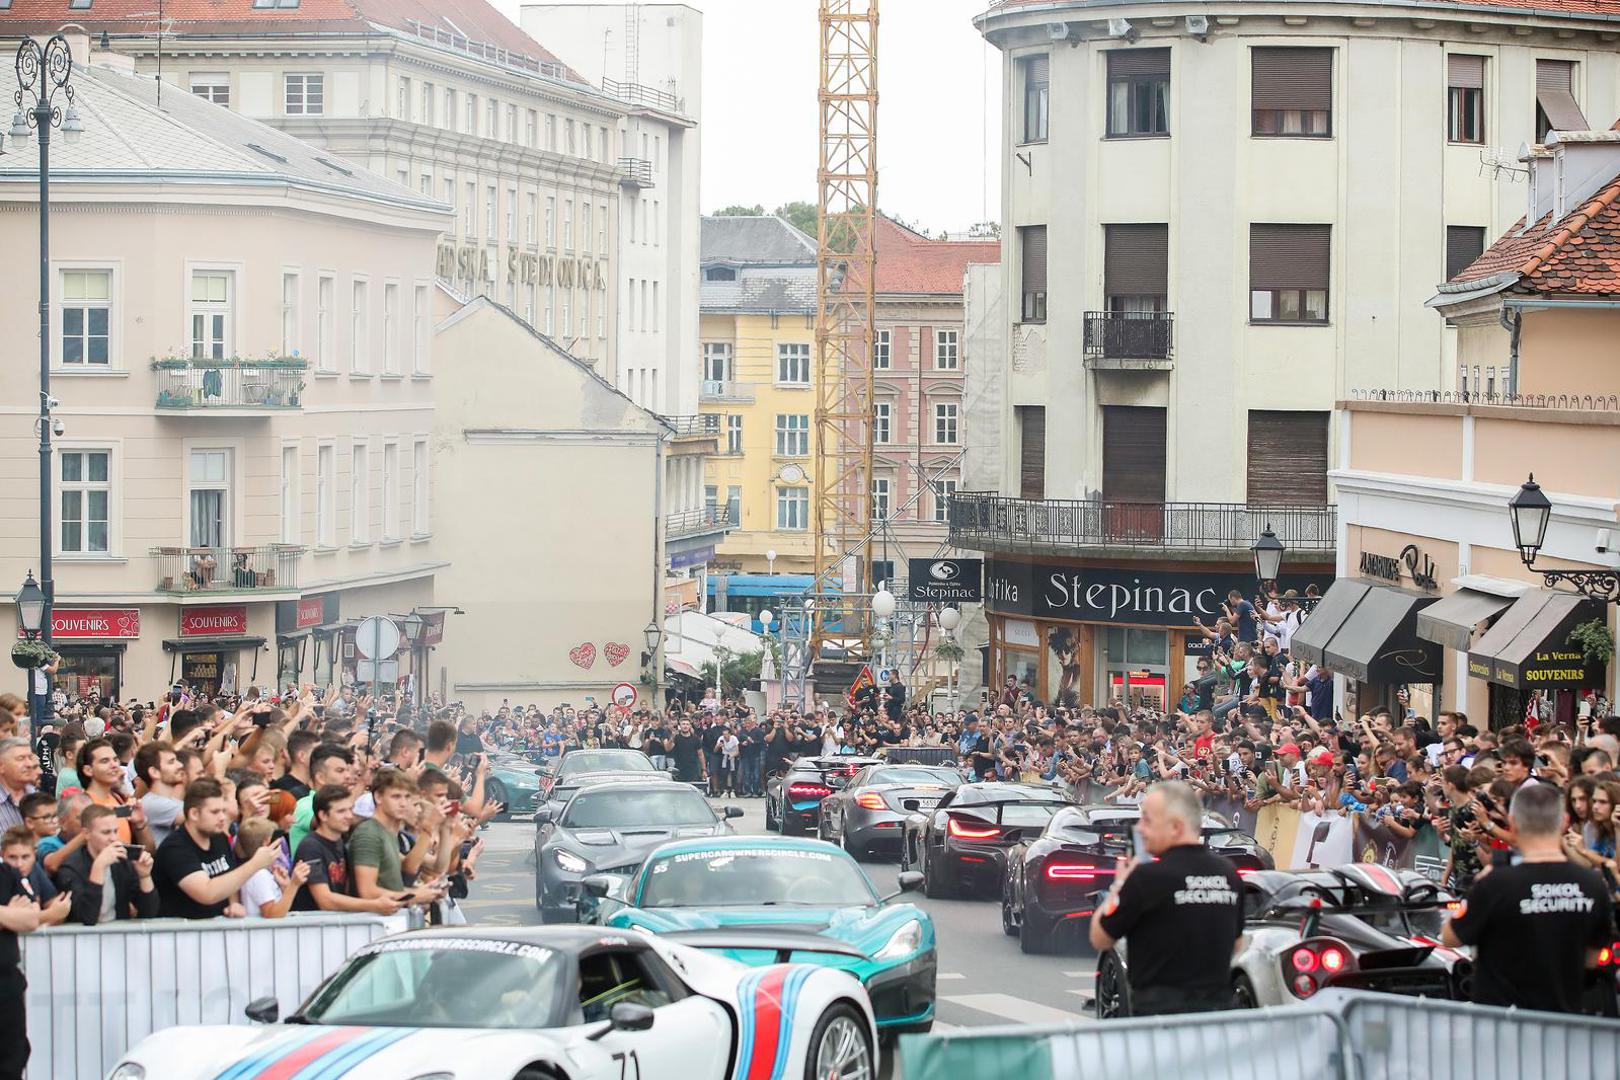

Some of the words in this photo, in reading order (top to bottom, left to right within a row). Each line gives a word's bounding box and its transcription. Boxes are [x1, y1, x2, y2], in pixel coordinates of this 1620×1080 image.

[914, 586, 976, 600] Stepinac
[1045, 573, 1217, 619] Stepinac
[52, 619, 109, 631] SOUVENIRS
[190, 615, 238, 629] SOUVENIRS
[1536, 652, 1549, 661] La
[1552, 651, 1581, 661] Verna
[1469, 661, 1489, 676] Souvenirs
[1526, 670, 1584, 680] SOUVENIRS
[1185, 875, 1231, 890] SOKOL
[1174, 890, 1238, 905] SECURITY
[1531, 883, 1584, 898] SOKOL
[1520, 897, 1595, 914] SECURITY
[611, 1050, 640, 1080] 71
